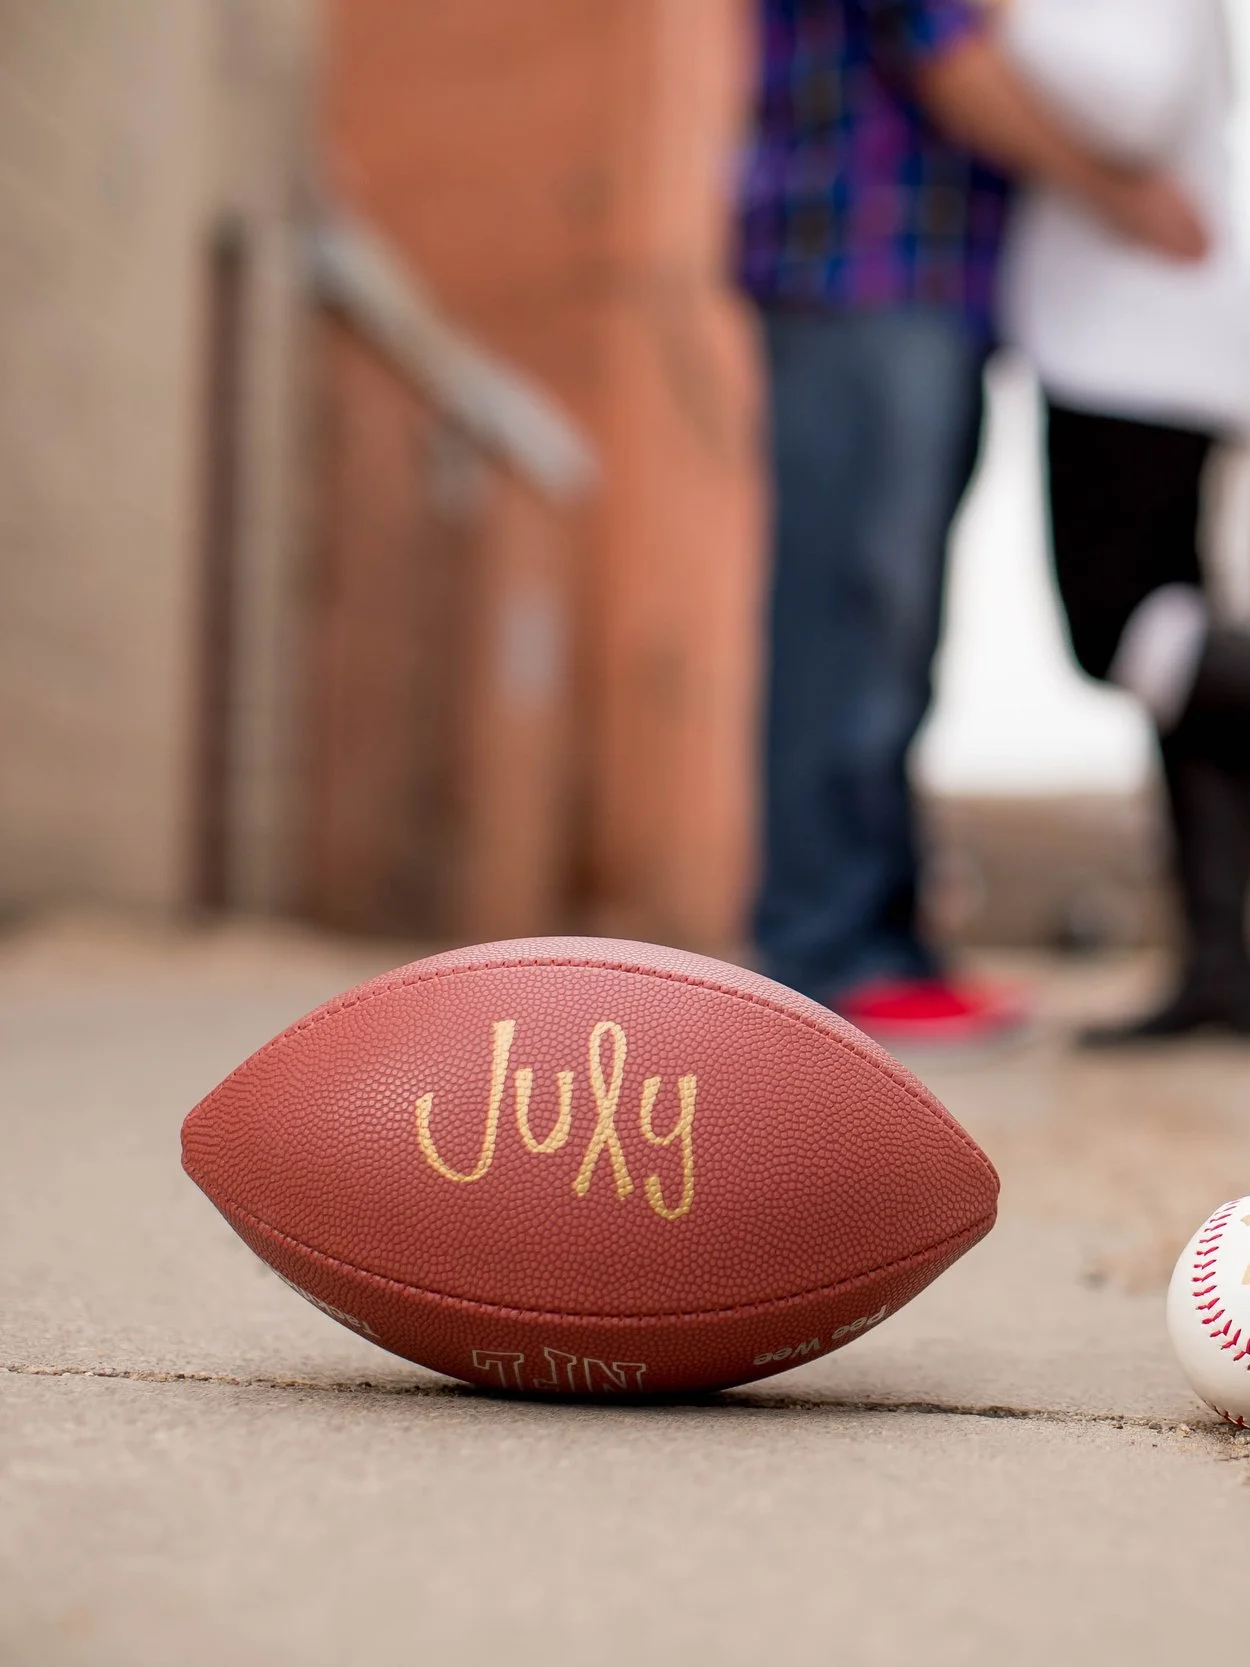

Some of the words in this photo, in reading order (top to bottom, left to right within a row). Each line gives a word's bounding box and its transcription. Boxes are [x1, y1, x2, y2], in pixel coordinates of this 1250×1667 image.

[415, 1018, 698, 1221] July
[831, 1305, 887, 1340] Pee
[753, 1337, 820, 1366] Wee
